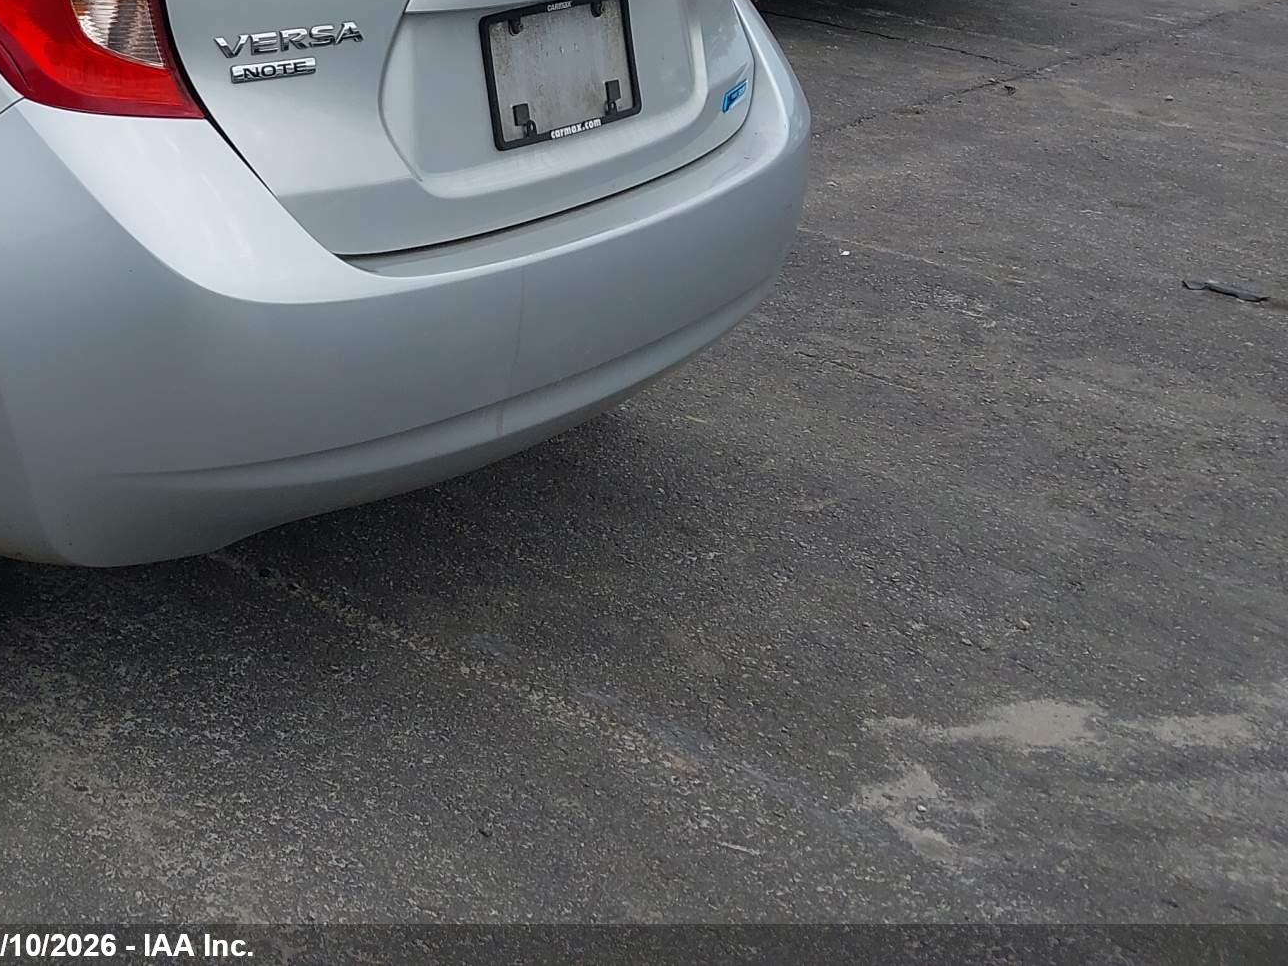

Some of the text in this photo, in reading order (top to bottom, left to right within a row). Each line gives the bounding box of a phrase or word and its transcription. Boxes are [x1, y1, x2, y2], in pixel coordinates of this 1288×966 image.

[213, 20, 364, 59] VERSA
[242, 60, 309, 80] NOTE
[550, 118, 602, 139] carmax.com
